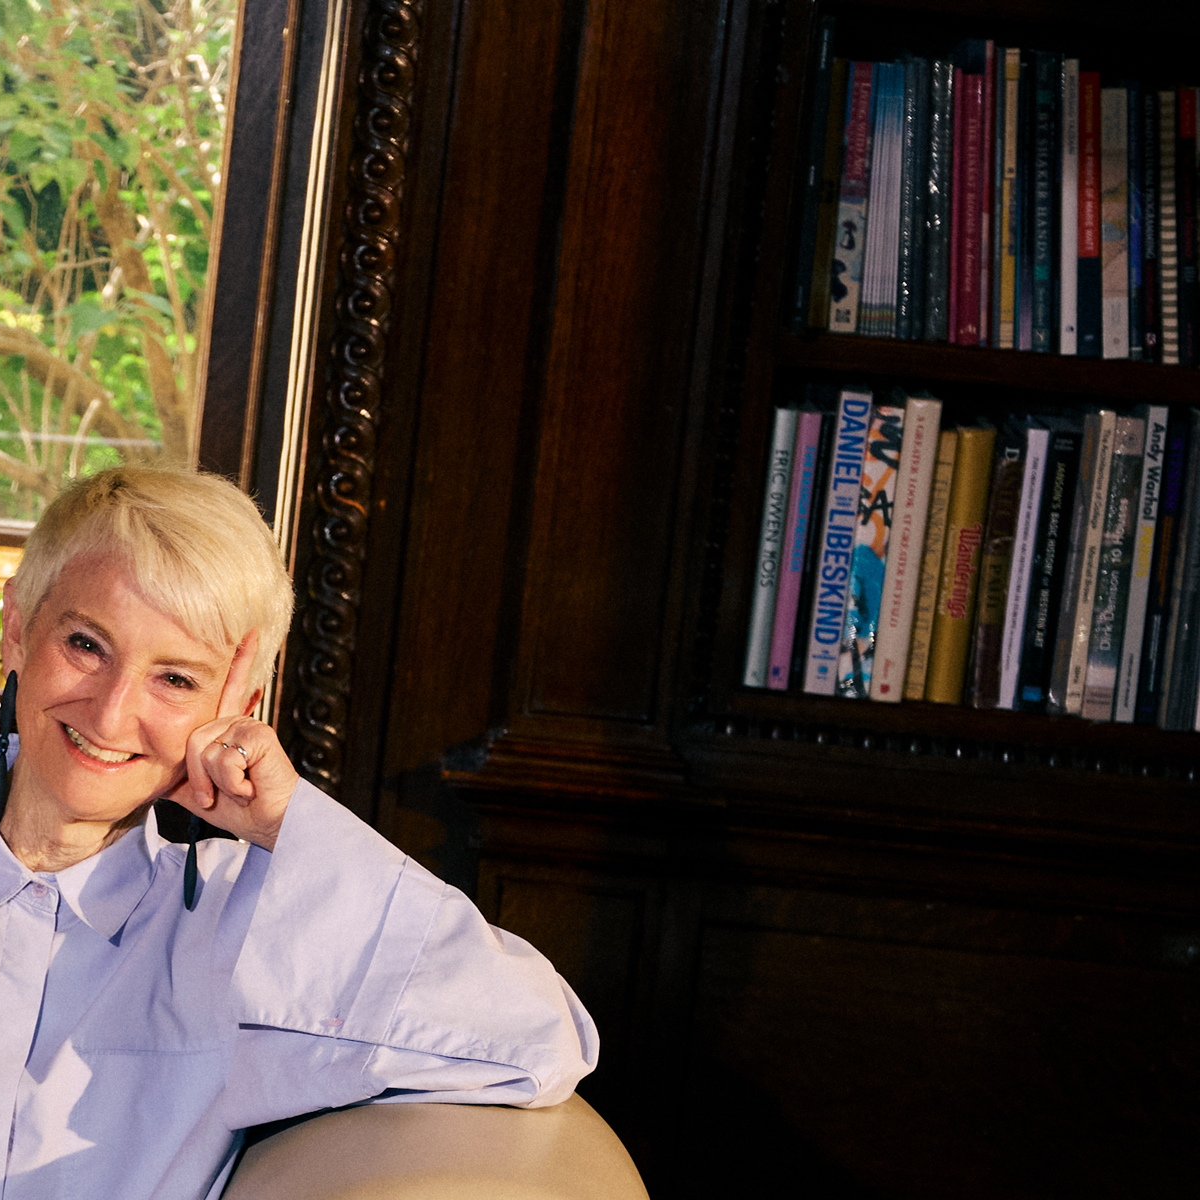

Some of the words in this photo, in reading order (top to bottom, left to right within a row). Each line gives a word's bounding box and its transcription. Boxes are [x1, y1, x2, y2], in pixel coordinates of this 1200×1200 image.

[968, 118, 978, 141] THE
[1037, 112, 1048, 130] BY
[1084, 138, 1093, 153] THE
[967, 146, 977, 188] FINEST
[1036, 138, 1048, 198] SHAKER
[966, 192, 976, 233] ROOMS
[1084, 200, 1093, 227] MARIE
[1085, 187, 1093, 199] OF
[1036, 205, 1048, 260] HANDS
[1084, 228, 1093, 250] WATT
[1144, 188, 1155, 259] PROGRAMMING
[964, 253, 974, 292] America
[833, 399, 869, 493] DANIEL
[909, 423, 924, 474] GREATER
[1146, 421, 1165, 462] Andy
[771, 448, 790, 485] ERIC
[1050, 461, 1066, 510] JANSON'S
[904, 477, 917, 508] LOOK
[1141, 465, 1161, 521] Warhol
[764, 491, 784, 543] OWEN
[1046, 511, 1060, 538] BASIC
[1113, 497, 1129, 545] Houses
[758, 548, 777, 589] MOSS
[896, 524, 911, 577] GREATER
[945, 520, 983, 620] Wanderings
[1041, 538, 1057, 576] HISTORY
[1110, 547, 1122, 563] 10
[1134, 524, 1154, 578] PRINTS
[813, 508, 855, 646] LIBESKIND
[1081, 578, 1092, 603] Brown
[1034, 587, 1050, 630] WESTERN
[1032, 630, 1045, 648] ART
[1098, 623, 1112, 651] Dirk
